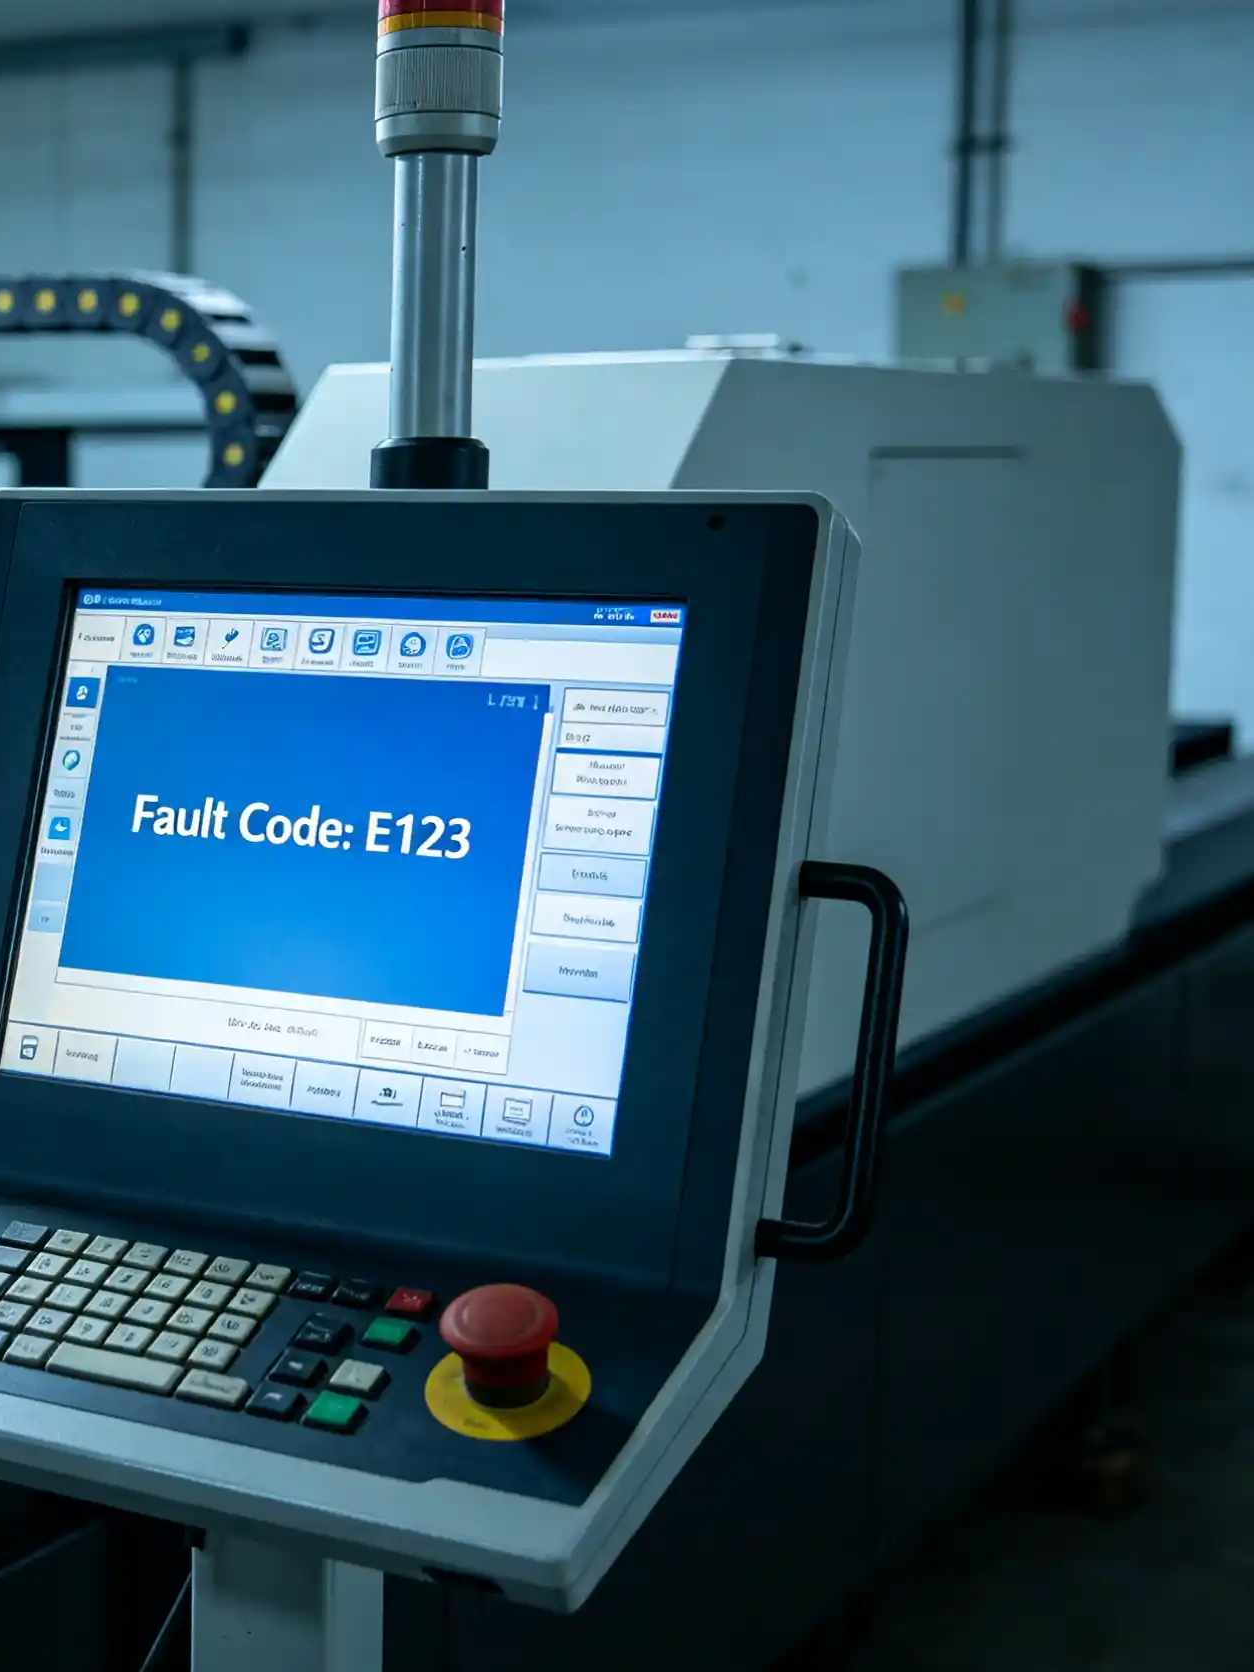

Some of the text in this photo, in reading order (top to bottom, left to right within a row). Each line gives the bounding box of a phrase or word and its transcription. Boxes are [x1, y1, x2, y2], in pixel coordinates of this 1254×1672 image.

[131, 794, 471, 859] Fault Code: E123
